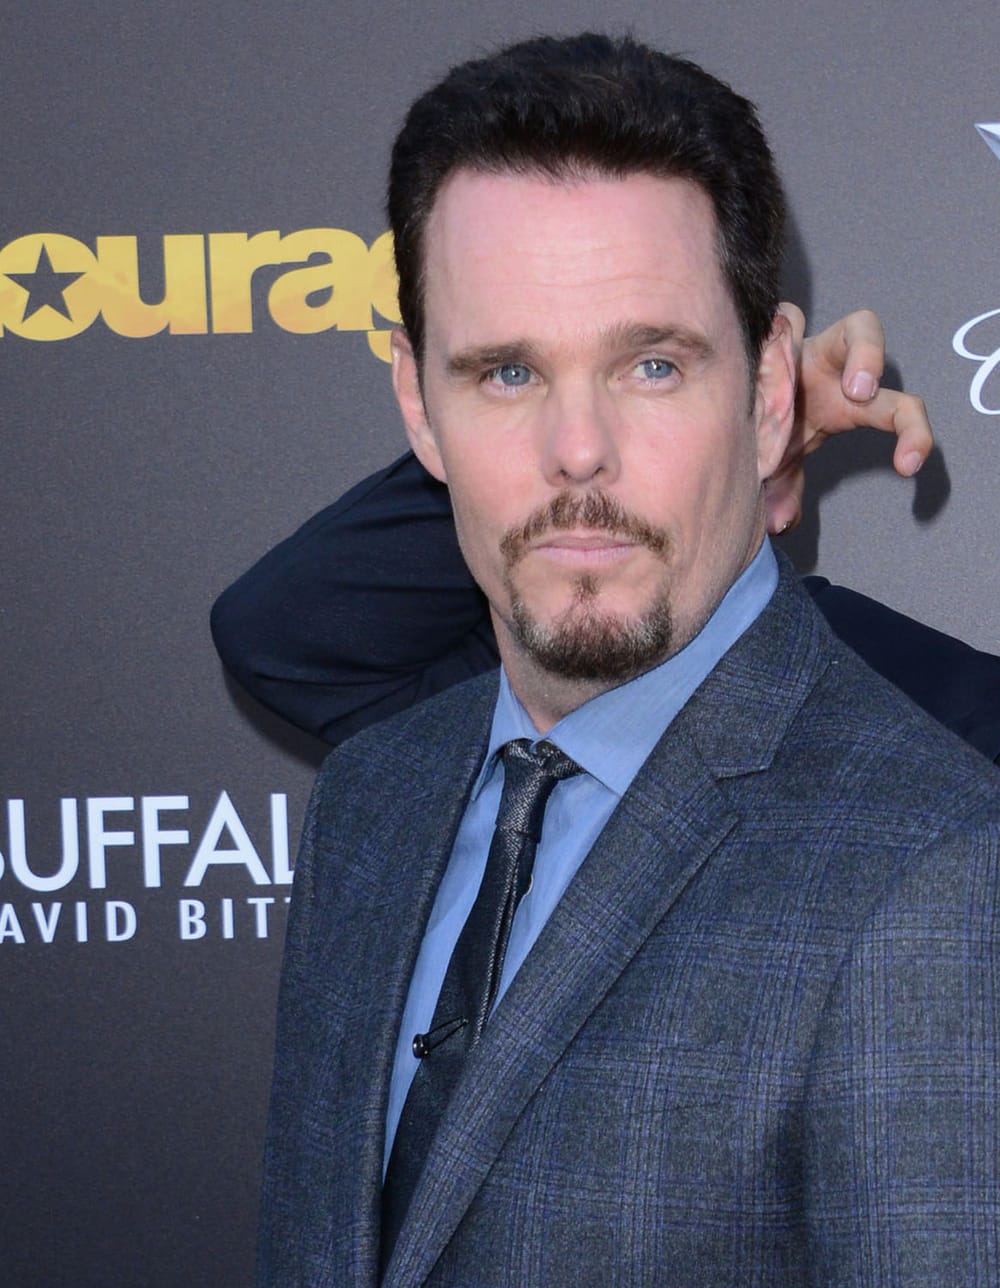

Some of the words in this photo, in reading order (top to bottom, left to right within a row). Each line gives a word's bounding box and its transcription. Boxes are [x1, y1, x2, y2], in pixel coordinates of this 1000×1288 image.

[0, 228, 404, 363] oura
[0, 790, 294, 892] UFFAL
[178, 897, 291, 940] BIT
